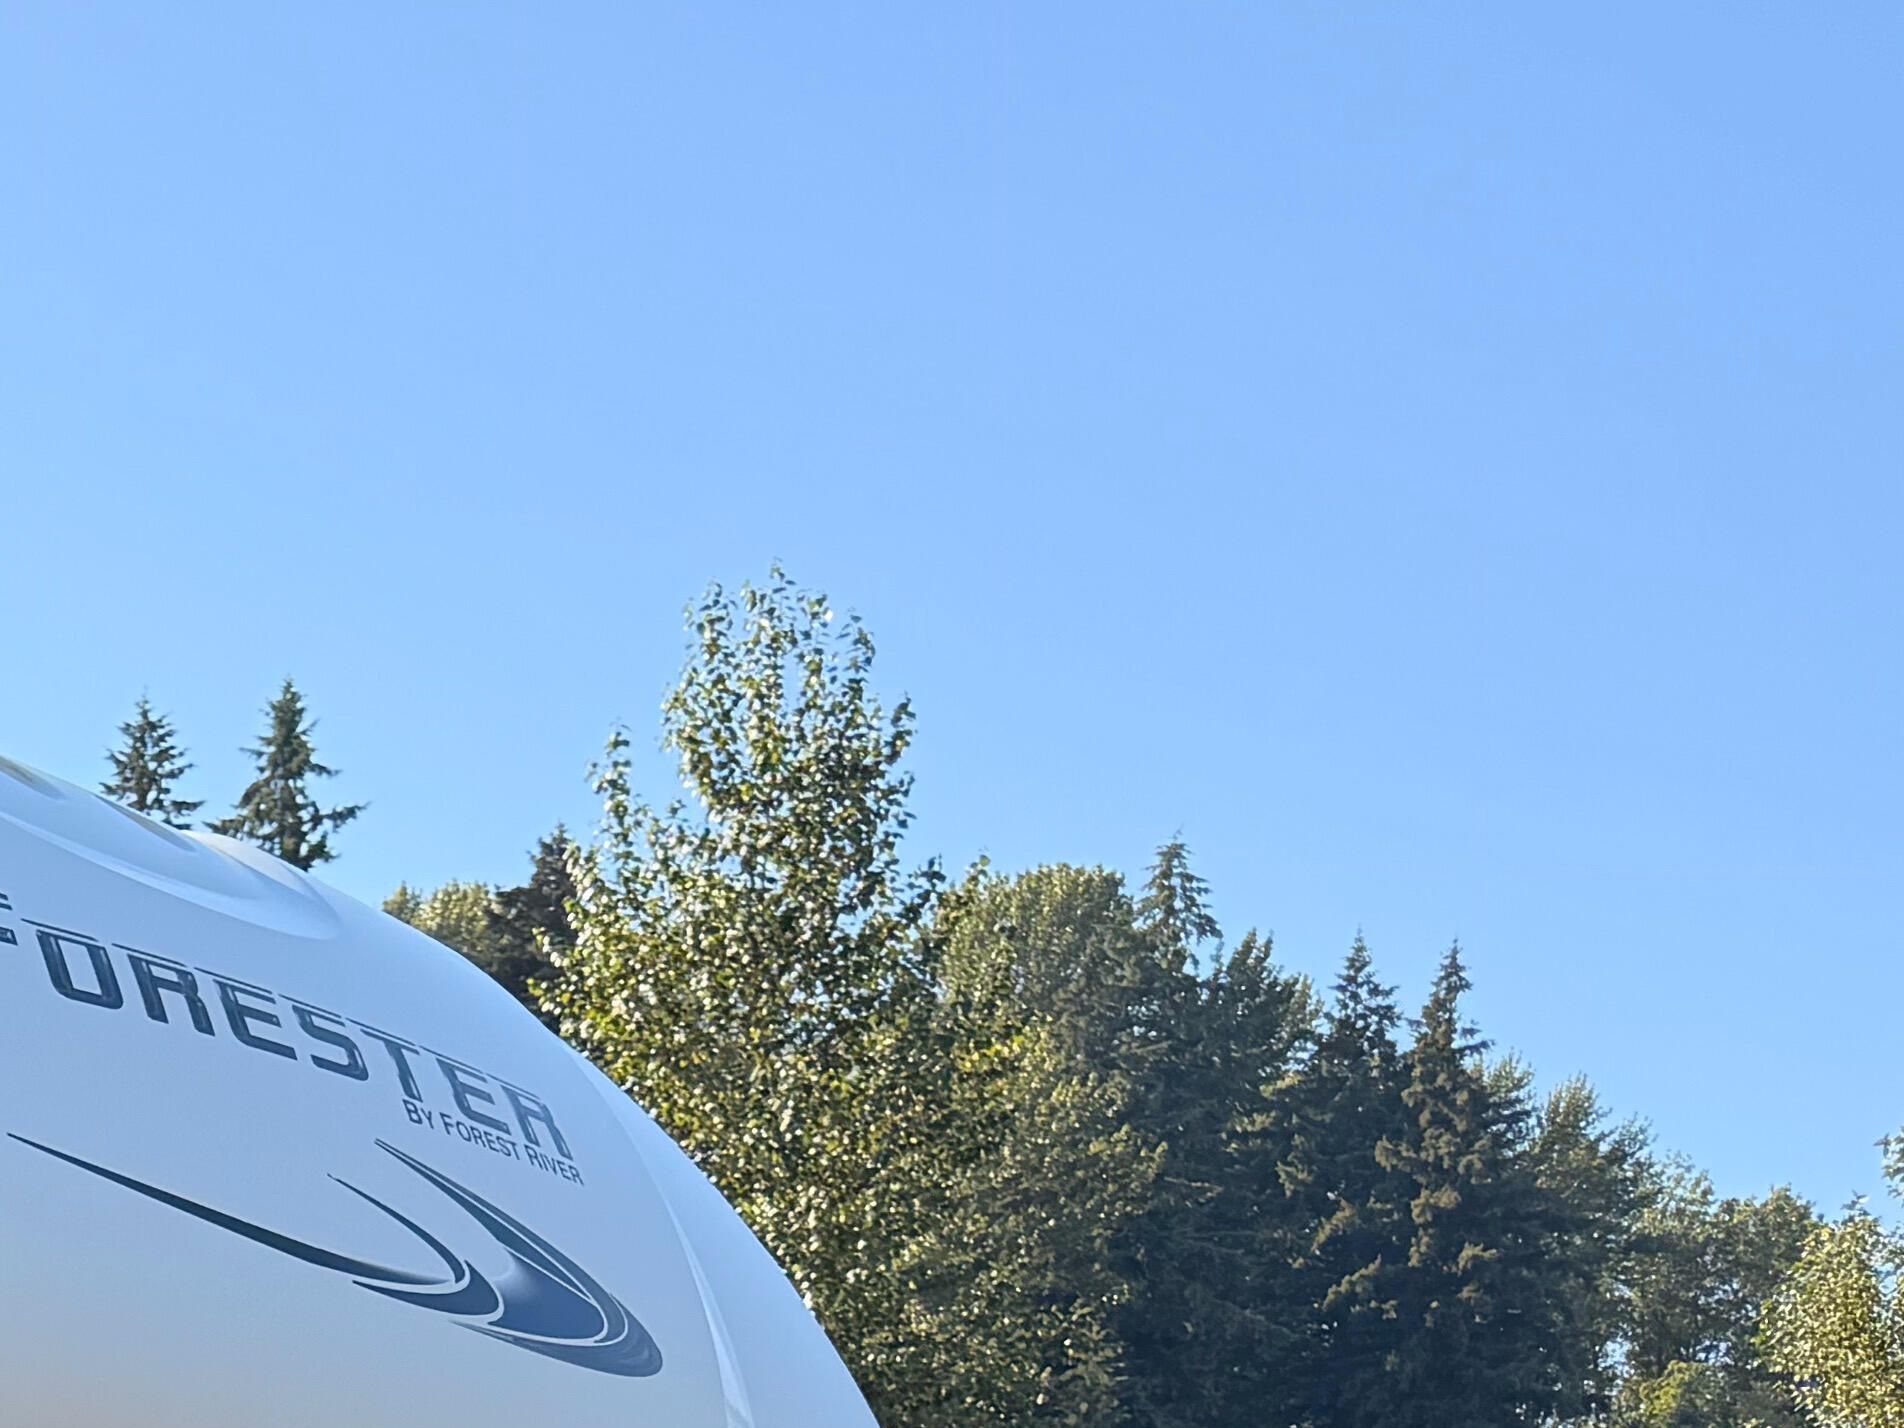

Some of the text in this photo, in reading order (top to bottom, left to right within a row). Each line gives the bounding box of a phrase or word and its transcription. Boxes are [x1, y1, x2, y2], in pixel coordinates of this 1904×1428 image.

[402, 1098, 585, 1187] BY FOREST RIVER
